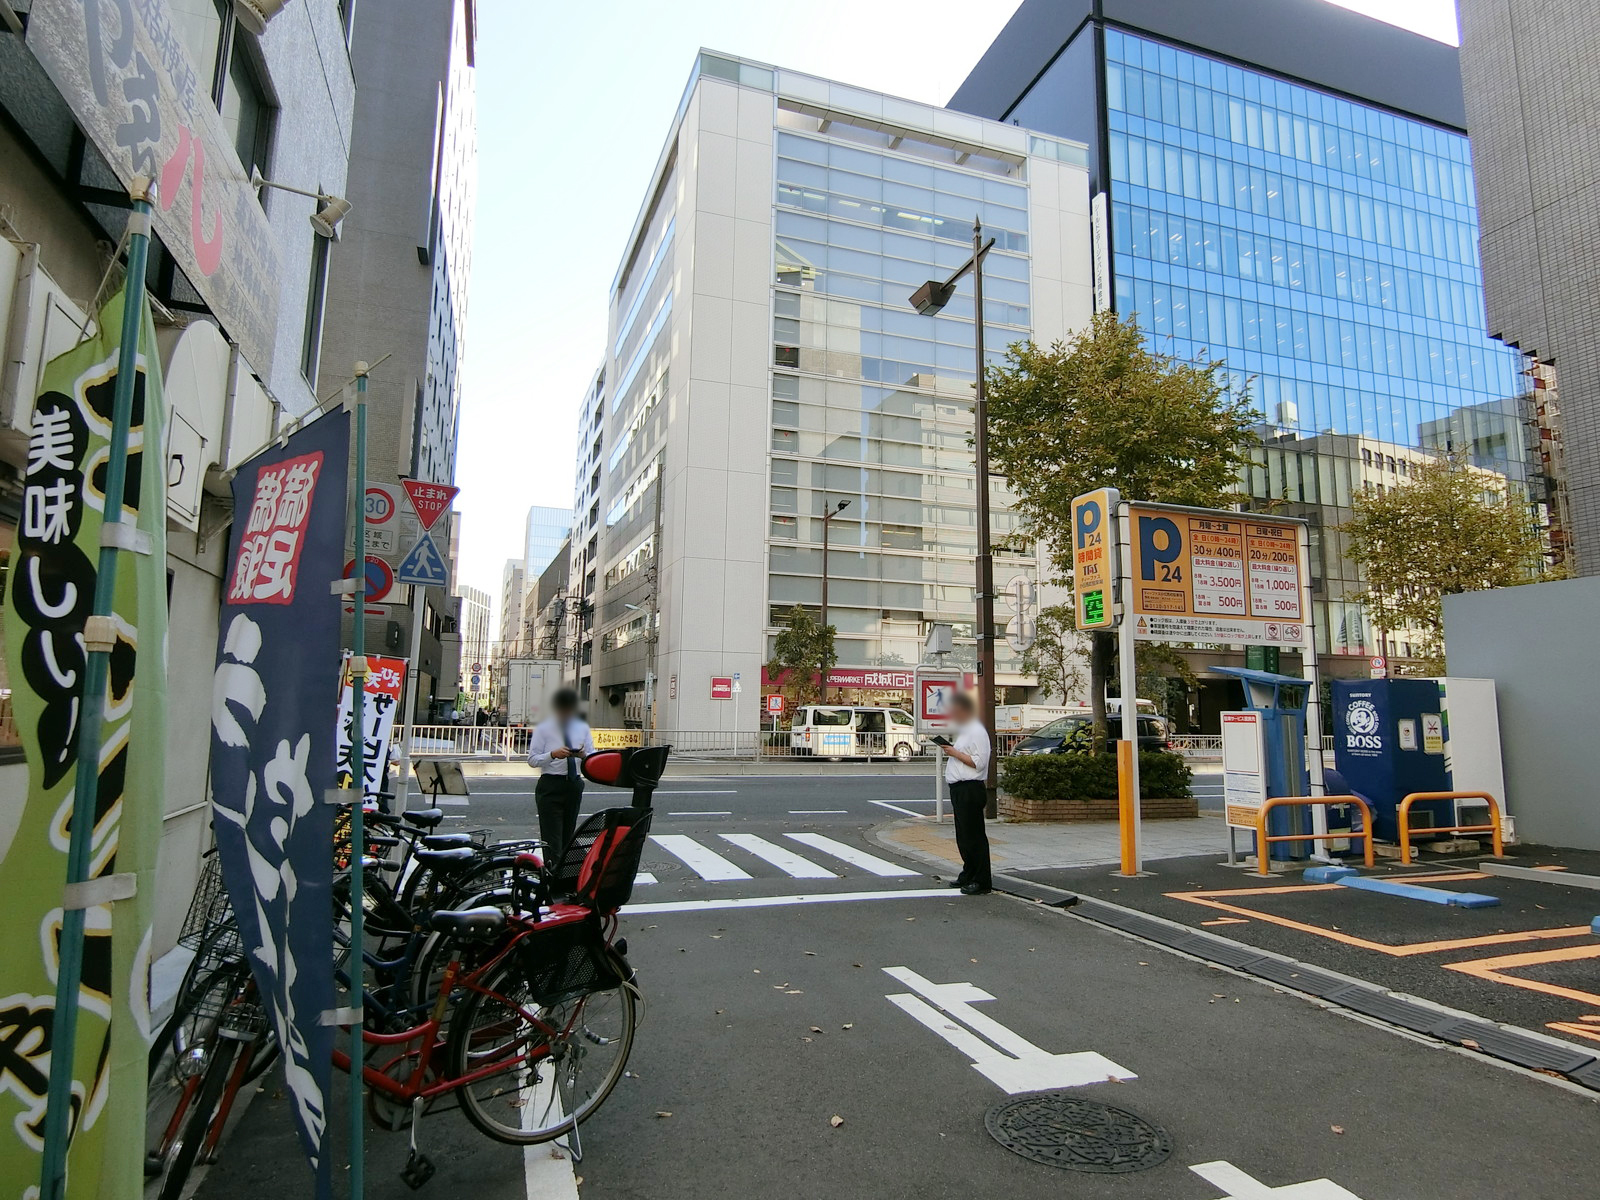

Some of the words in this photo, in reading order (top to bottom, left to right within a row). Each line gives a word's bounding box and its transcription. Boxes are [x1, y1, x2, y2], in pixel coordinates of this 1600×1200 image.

[413, 486, 448, 501] 止まれ
[365, 497, 387, 515] 30
[418, 501, 442, 511] STOP
[1088, 532, 1102, 547] 24
[1078, 547, 1102, 564] 時間貸
[1194, 544, 1240, 558] 30分/400円
[1250, 549, 1294, 562] 20分/200円
[1161, 565, 1182, 583] 24
[1209, 576, 1242, 588] 3,500円
[1266, 579, 1296, 592] 1,000円
[1218, 596, 1243, 608] 500円
[1274, 600, 1298, 612] 500円
[826, 675, 864, 684] UPERMARKET
[1348, 700, 1375, 711] COFFEE
[1346, 735, 1382, 749] BOSS
